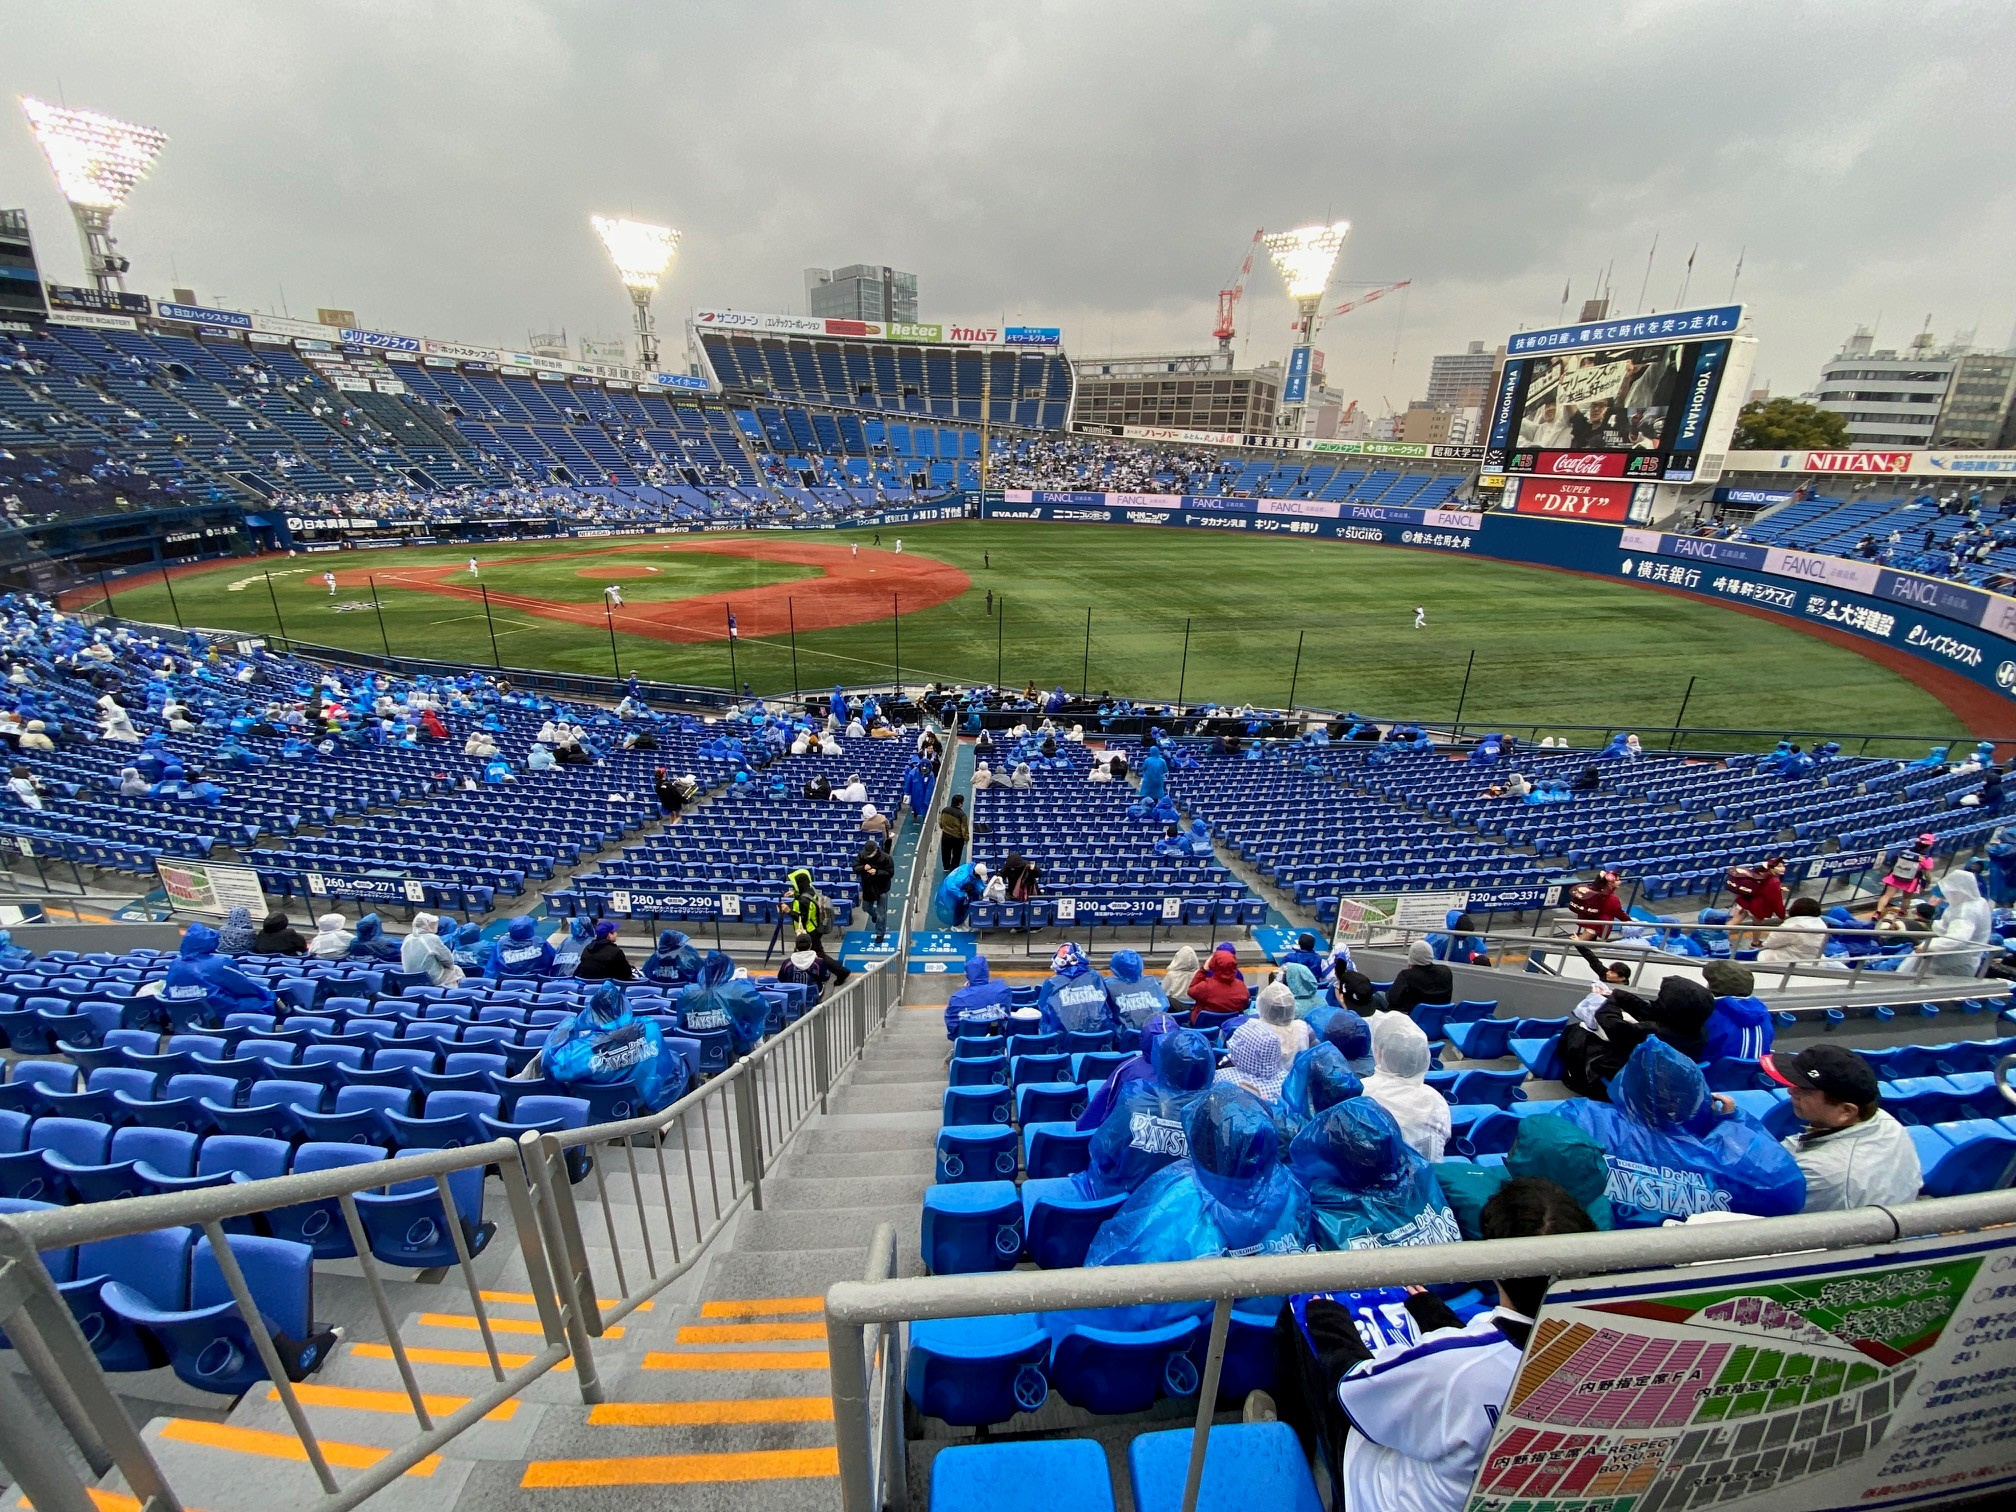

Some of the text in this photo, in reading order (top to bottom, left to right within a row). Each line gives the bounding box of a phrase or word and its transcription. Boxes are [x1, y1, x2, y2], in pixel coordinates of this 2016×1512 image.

[66, 315, 94, 323] COFFEE
[174, 307, 249, 326] 日立ハイシステム21
[717, 314, 759, 326] サニクリーン
[891, 323, 938, 337] Retec
[950, 328, 998, 342] オカムラ
[354, 331, 419, 350] リビングライフ
[1005, 333, 1059, 343] メモワールグループ
[441, 346, 487, 358] ホットスタッフ
[533, 358, 563, 369] 明和地所
[660, 375, 707, 389] ウスイホーム
[1499, 369, 1519, 426] YOKOHAMA
[1682, 370, 1712, 439] YOKOHAMA
[1607, 414, 1616, 428] 4
[1082, 425, 1113, 435] wamiles
[1142, 429, 1179, 438] ハーバー
[1375, 445, 1424, 455] 住友ベークライト
[1434, 446, 1471, 458] 昭和大学
[1806, 453, 1887, 471] NITTAN
[1559, 484, 1592, 494] SUPER
[1728, 490, 1766, 502] UYENO
[1043, 493, 1074, 503] FANCL
[1117, 495, 1147, 505] FANCL
[1192, 498, 1224, 509] FANCL
[1270, 501, 1303, 513] FANCL
[1352, 506, 1387, 520] FANCL
[919, 509, 938, 520] MID
[1437, 513, 1475, 528] FANCL
[1200, 518, 1247, 528] タカナシ乳業
[1345, 530, 1383, 541] SUGIKO
[1412, 531, 1472, 549] 横浜信用金庫
[1674, 539, 1718, 559] FANCL
[1637, 560, 1702, 588] 横浜銀行
[1781, 555, 1826, 580] FANCL
[1712, 576, 1796, 607] 崎陽軒 シウマイ
[1891, 577, 1939, 607] FANCL
[1838, 603, 1896, 638] 大洋建設
[1920, 628, 1983, 667] レイズネクスト
[324, 877, 396, 892] 260 271
[631, 894, 712, 907] 280 290
[1469, 890, 1538, 903] 320 331
[1076, 901, 1155, 911] 300 310
[1059, 988, 1106, 1006] BAYSTARS
[1661, 1166, 1707, 1188] DeNA
[1415, 1203, 1437, 1229] DeNA
[1229, 1233, 1298, 1257] YOKOHAMA DeNA
[1608, 1437, 1679, 1454] RESPECT
